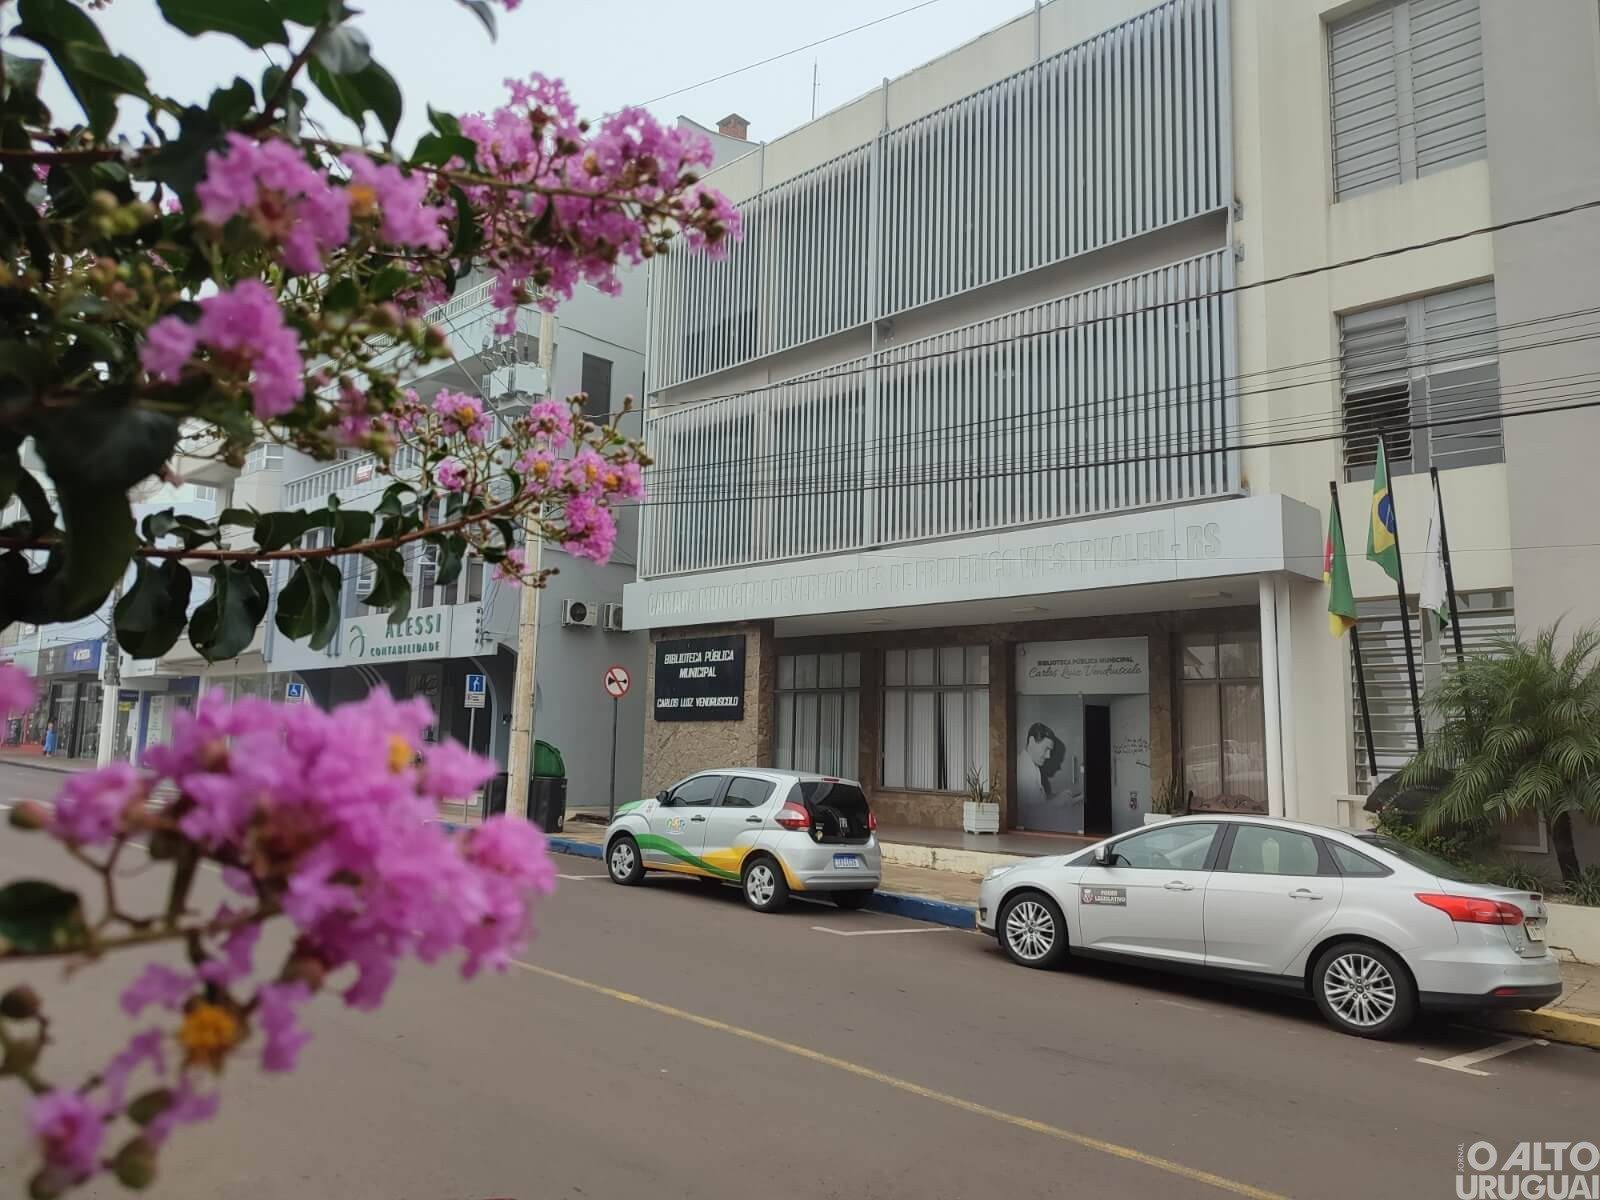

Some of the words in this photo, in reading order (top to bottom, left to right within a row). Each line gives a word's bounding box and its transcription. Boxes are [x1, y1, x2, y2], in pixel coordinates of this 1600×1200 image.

[890, 562, 912, 592] DE
[1186, 522, 1222, 560] RS
[385, 613, 441, 638] ALESSI
[370, 641, 440, 657] CONTABILIDADE
[664, 652, 702, 664] BIBLIOTECA
[704, 649, 734, 662] PÚBLICA
[679, 666, 717, 678] MUNICIPAL
[657, 698, 679, 708] CARLOS
[680, 698, 693, 707] LUIZ
[695, 696, 738, 707] VENDRUSCOLO
